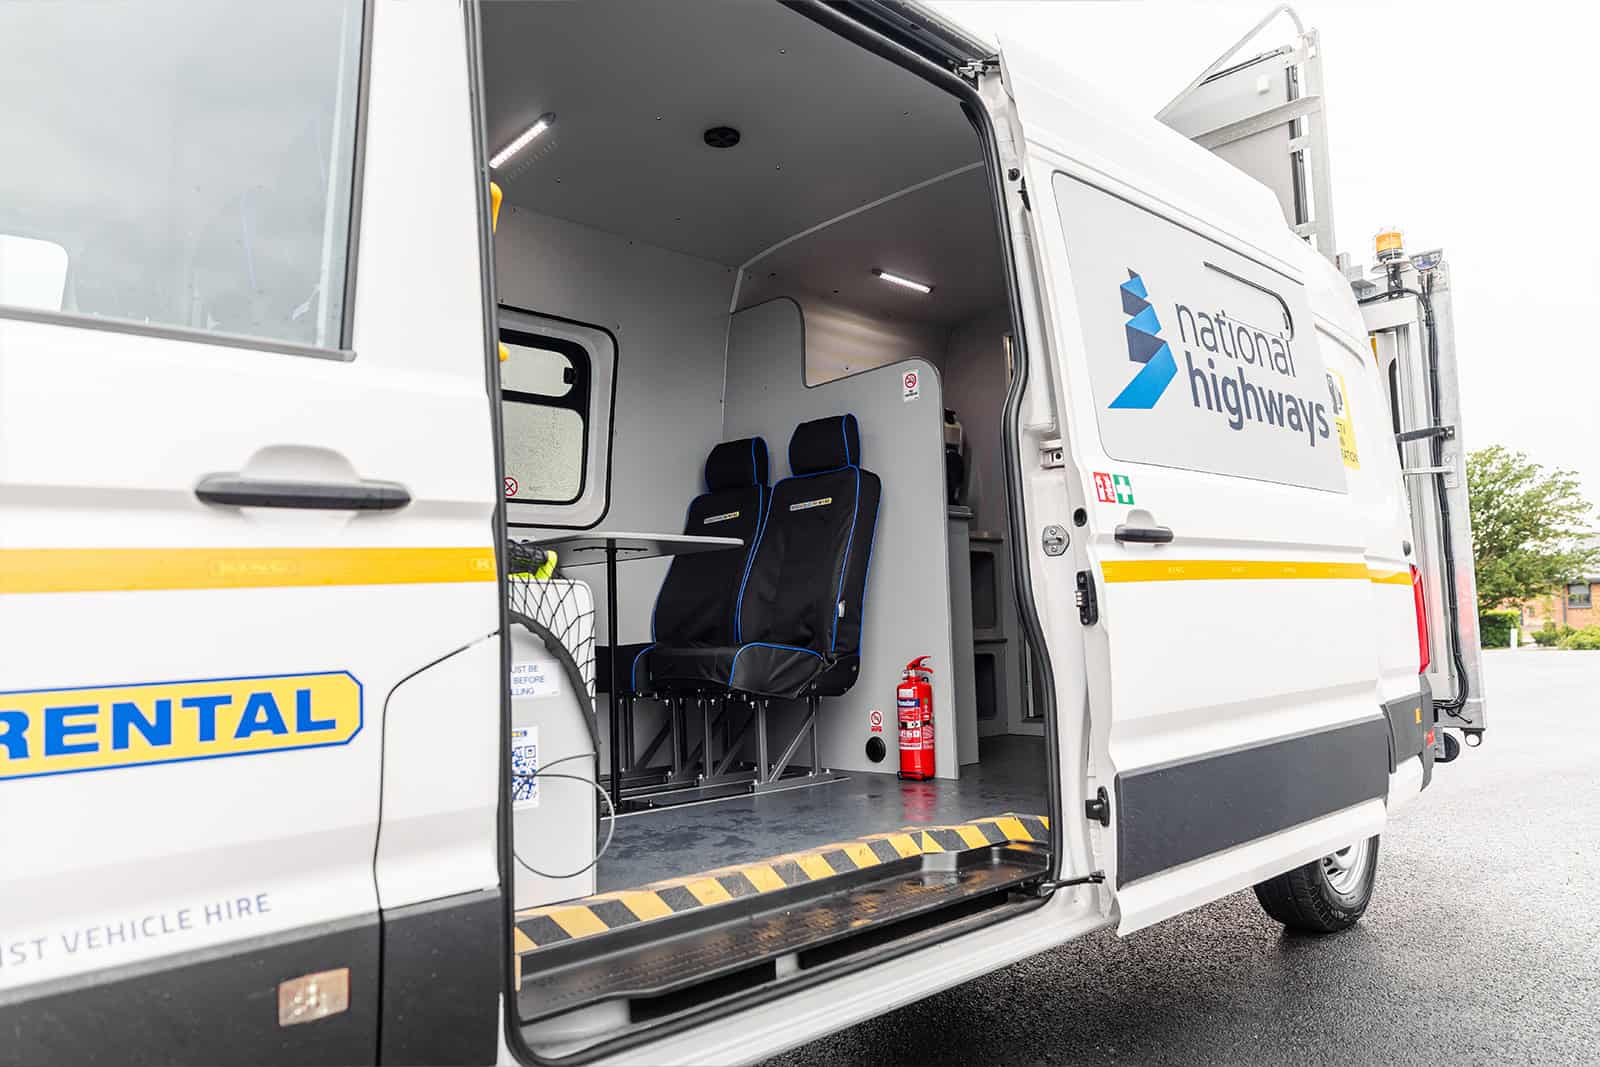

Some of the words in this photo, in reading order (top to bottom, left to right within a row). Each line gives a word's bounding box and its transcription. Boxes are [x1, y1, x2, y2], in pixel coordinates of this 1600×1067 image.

[1175, 303, 1297, 378] national
[1184, 350, 1330, 447] highways
[513, 674, 544, 685] BEFORE
[0, 689, 336, 760] RENTAL
[61, 909, 193, 954] VEHICLE
[204, 893, 272, 925] HIRE
